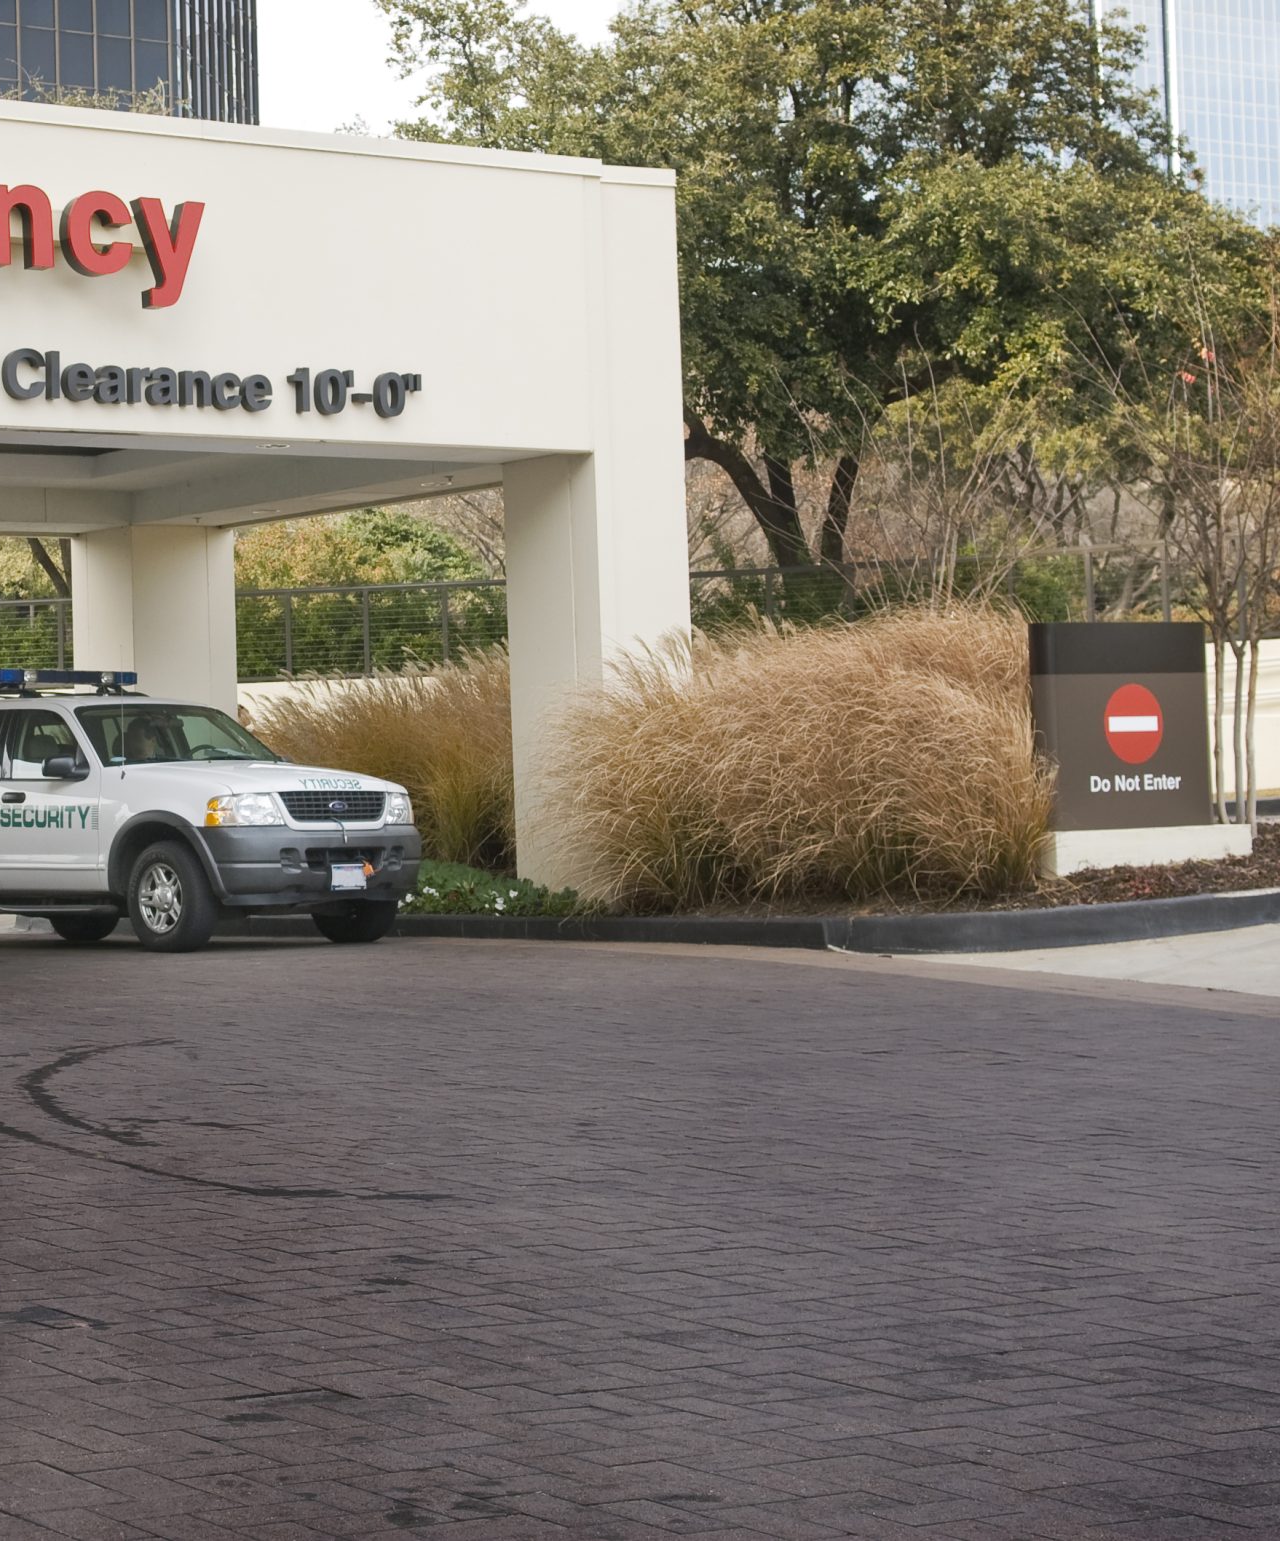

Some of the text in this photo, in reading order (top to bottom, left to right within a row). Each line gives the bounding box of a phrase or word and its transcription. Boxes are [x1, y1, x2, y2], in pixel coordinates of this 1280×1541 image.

[1, 347, 273, 412] Clearance
[1090, 773, 1182, 793] Do Not Enter
[0, 805, 90, 829] SECURITY
